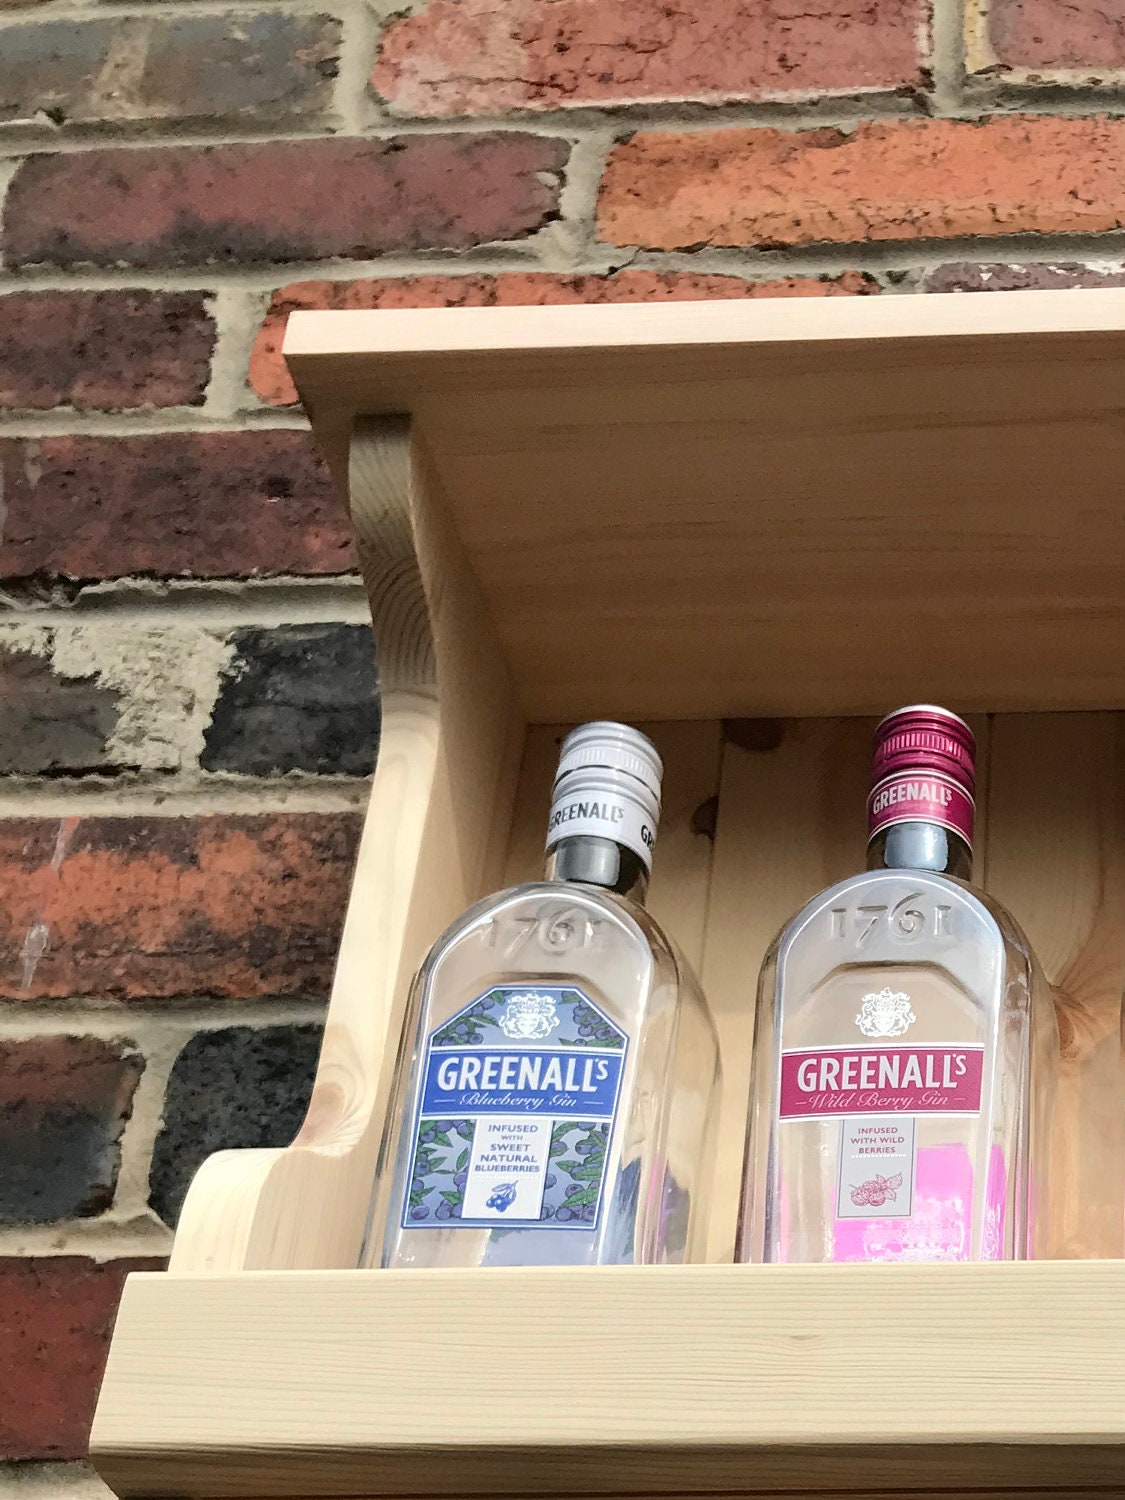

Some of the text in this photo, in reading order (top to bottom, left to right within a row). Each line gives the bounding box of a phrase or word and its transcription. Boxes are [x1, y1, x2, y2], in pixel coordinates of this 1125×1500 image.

[872, 782, 953, 815] GREENALL'S
[831, 891, 951, 948] 1761
[437, 1056, 609, 1093] GREENALL'S
[797, 1054, 967, 1093] GREENALL'S
[459, 1092, 578, 1110] Blueberry Gin
[809, 1090, 949, 1110] Wild Berry Gin
[488, 1124, 539, 1133] INFUSED
[490, 1143, 531, 1151] SWEET
[858, 1146, 896, 1154] BERRIES
[480, 1154, 538, 1163] NATURAL
[474, 1164, 540, 1173] BLUEBERRIES
